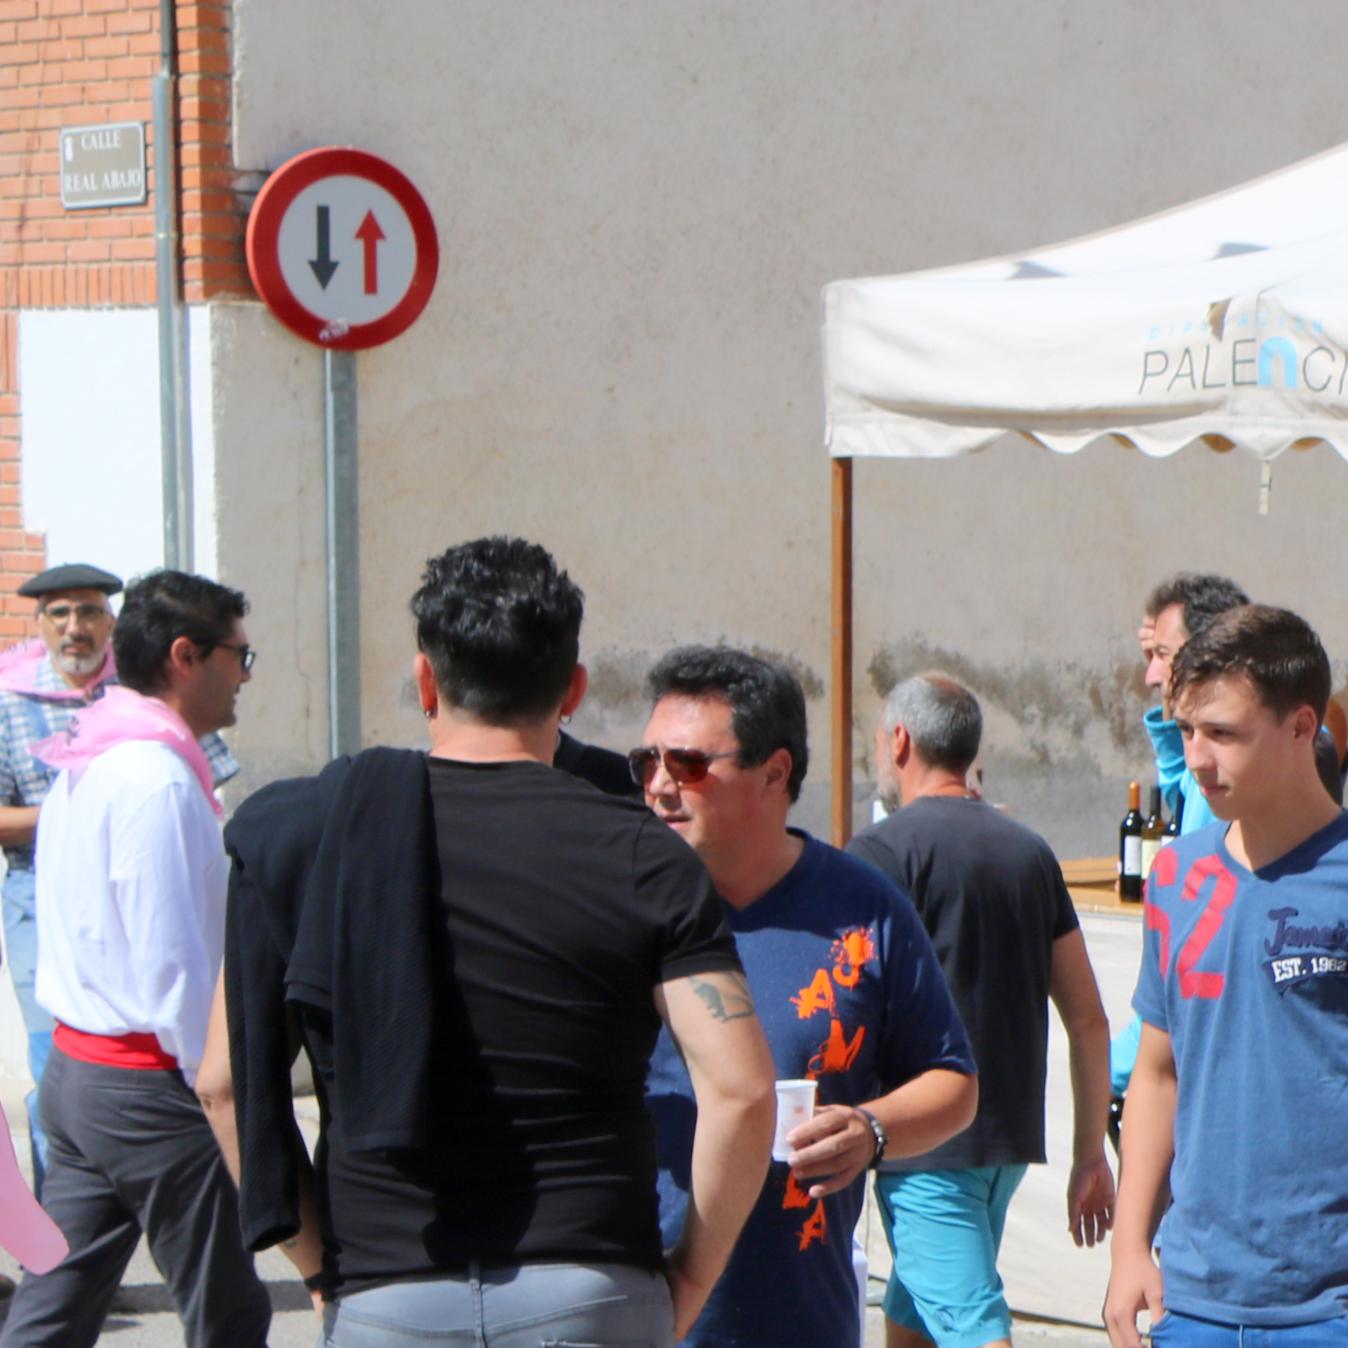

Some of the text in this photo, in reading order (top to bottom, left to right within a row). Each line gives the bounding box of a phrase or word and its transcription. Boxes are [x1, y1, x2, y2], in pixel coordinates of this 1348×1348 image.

[81, 131, 121, 151] CALLE
[64, 168, 141, 193] REAL ABAJO
[1271, 957, 1307, 983] EST.
